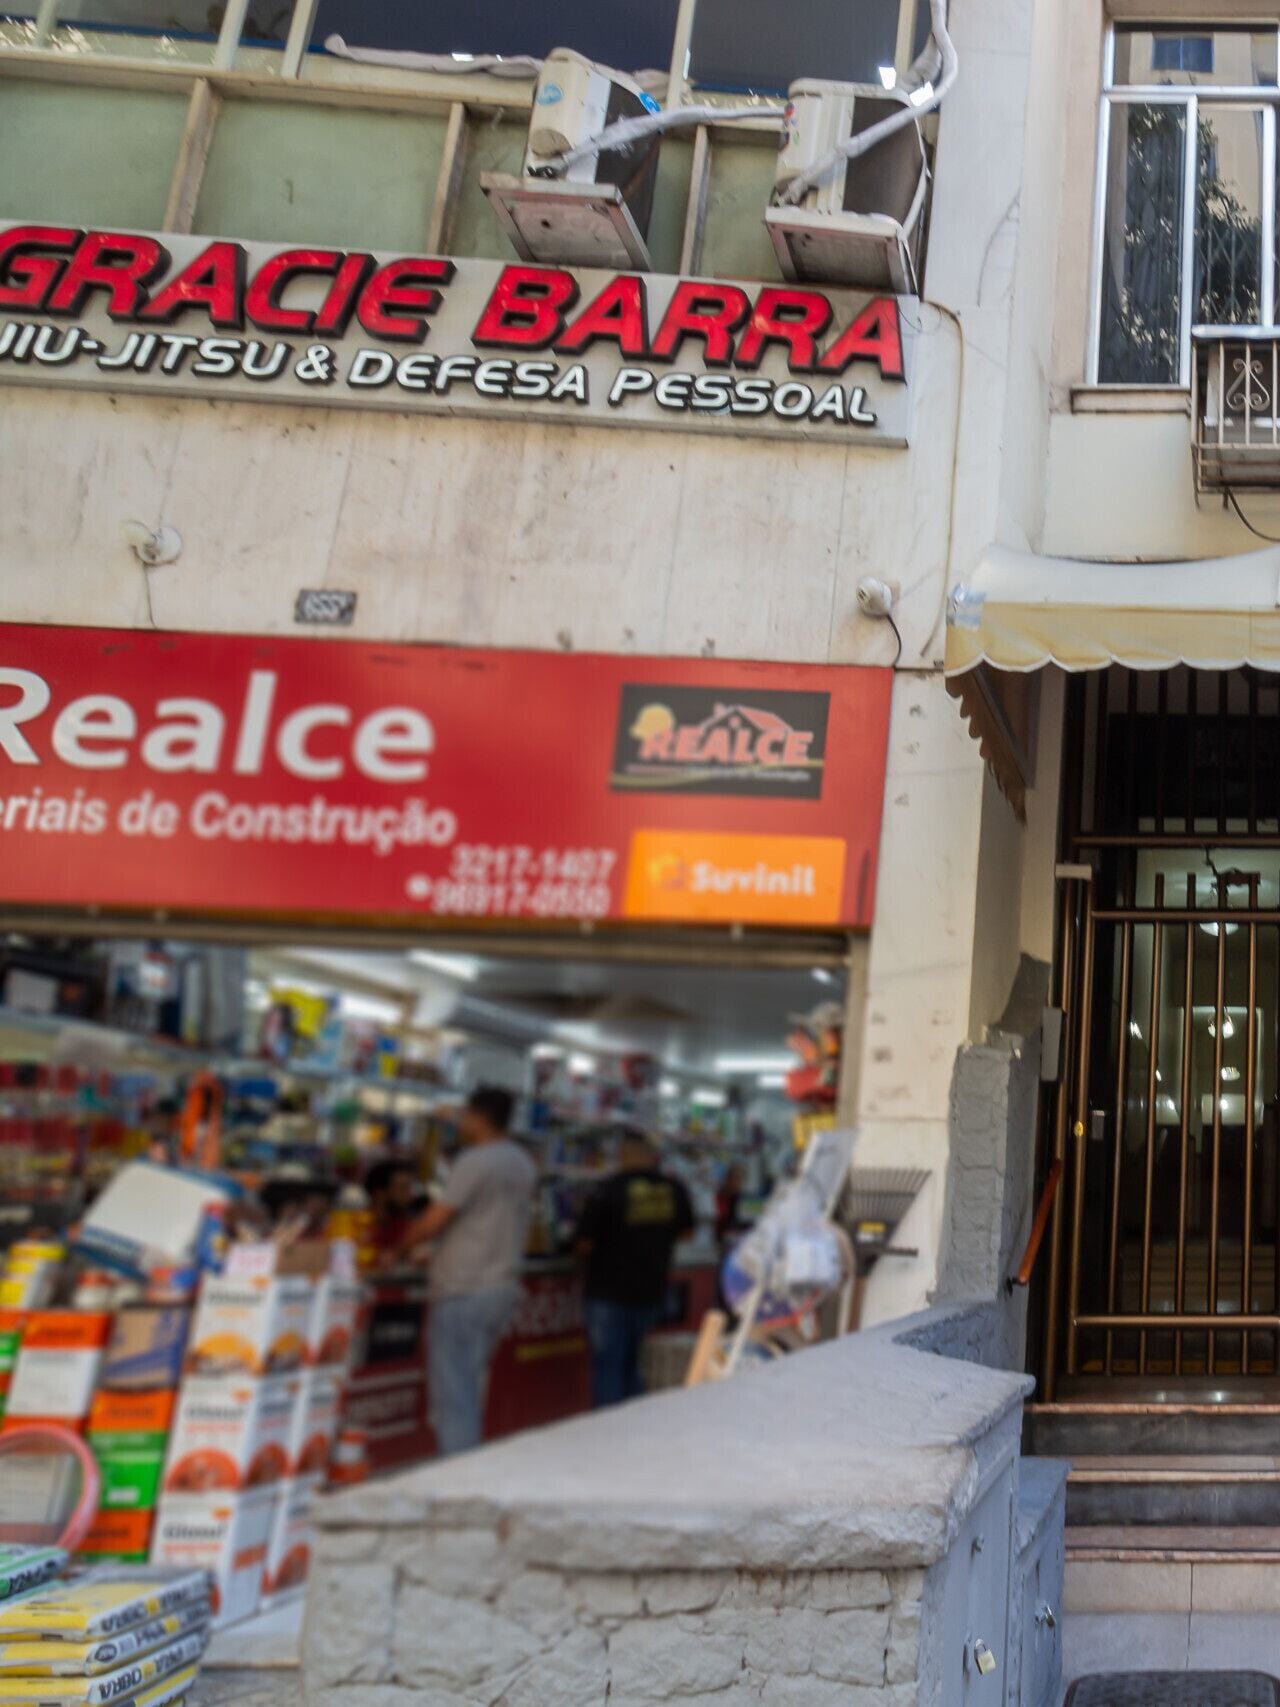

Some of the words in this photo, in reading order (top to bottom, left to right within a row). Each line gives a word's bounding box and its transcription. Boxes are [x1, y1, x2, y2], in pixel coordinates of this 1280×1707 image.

[0, 225, 457, 344] GRACIE
[471, 264, 907, 382] BARRA
[0, 323, 294, 381] JIU-JITSU
[295, 343, 336, 384] &
[347, 348, 588, 405] DEFESA
[608, 367, 879, 425] PESSOAL
[0, 666, 436, 783] Realce
[638, 725, 815, 766] REALCE
[0, 786, 107, 835] riais
[118, 789, 180, 838] de
[190, 791, 457, 859] Construção
[691, 861, 816, 896] Suvinil
